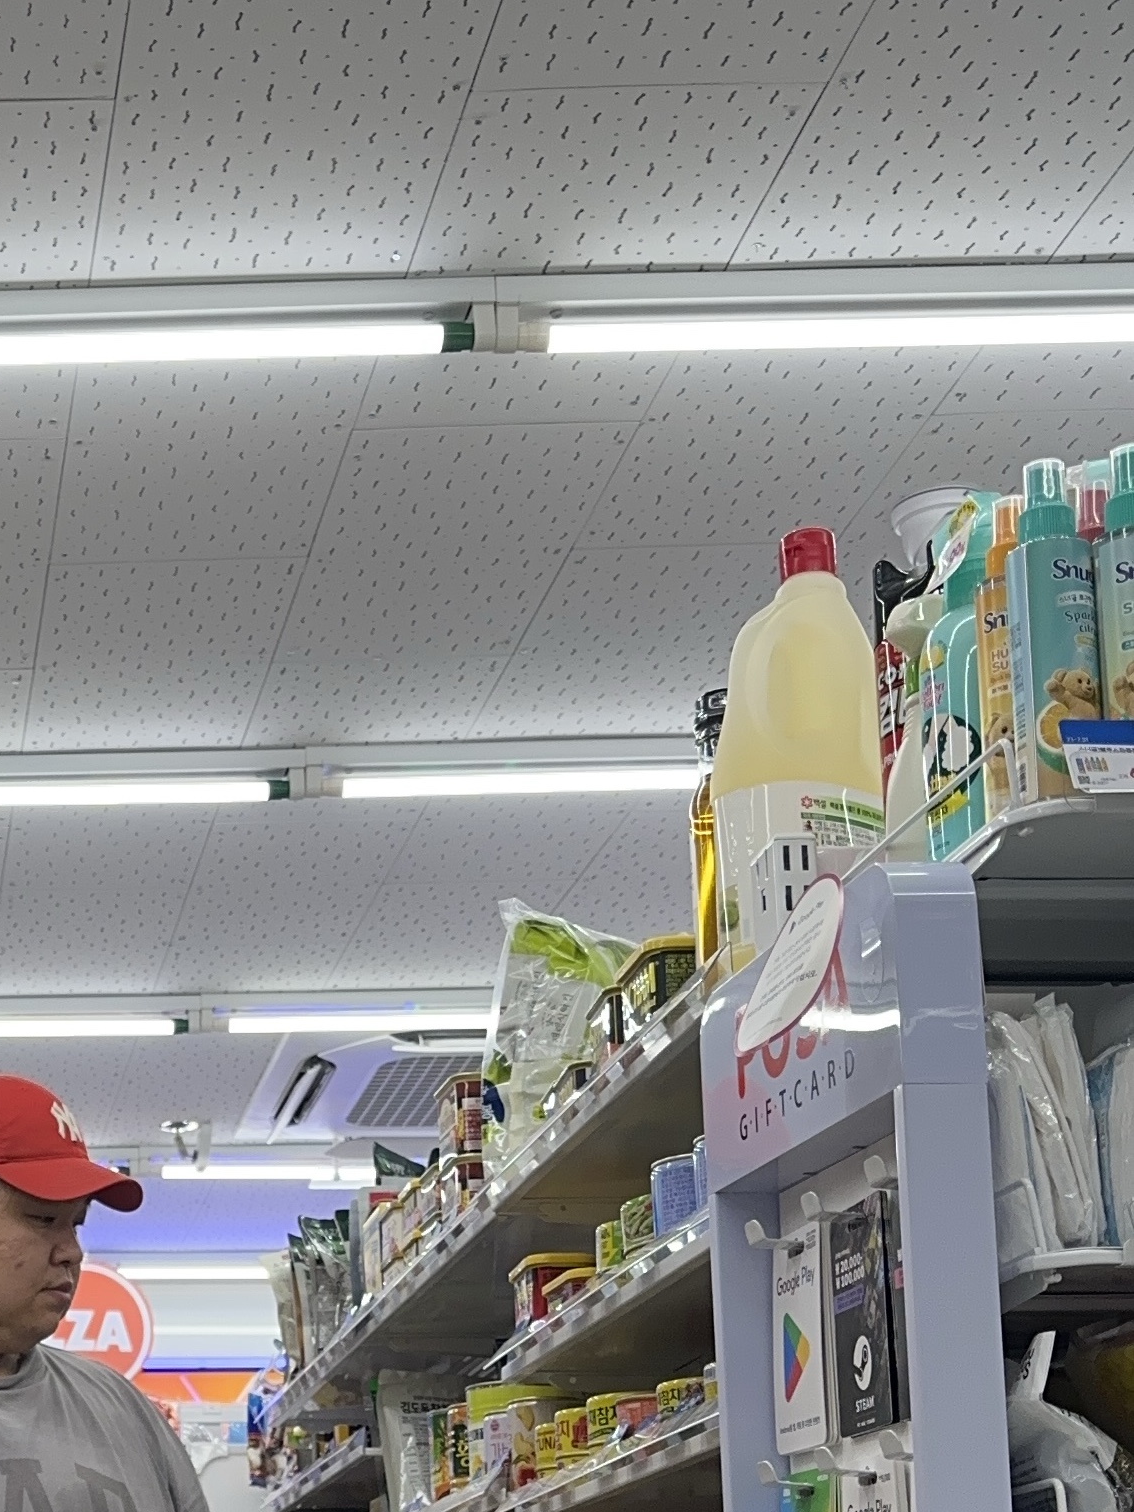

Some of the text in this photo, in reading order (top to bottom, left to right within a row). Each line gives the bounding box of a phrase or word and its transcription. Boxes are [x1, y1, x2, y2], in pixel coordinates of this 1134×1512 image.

[1052, 557, 1093, 588] Snug
[1116, 561, 1134, 585] Sn
[984, 613, 1007, 634] Sn
[776, 1265, 816, 1297] Google Play
